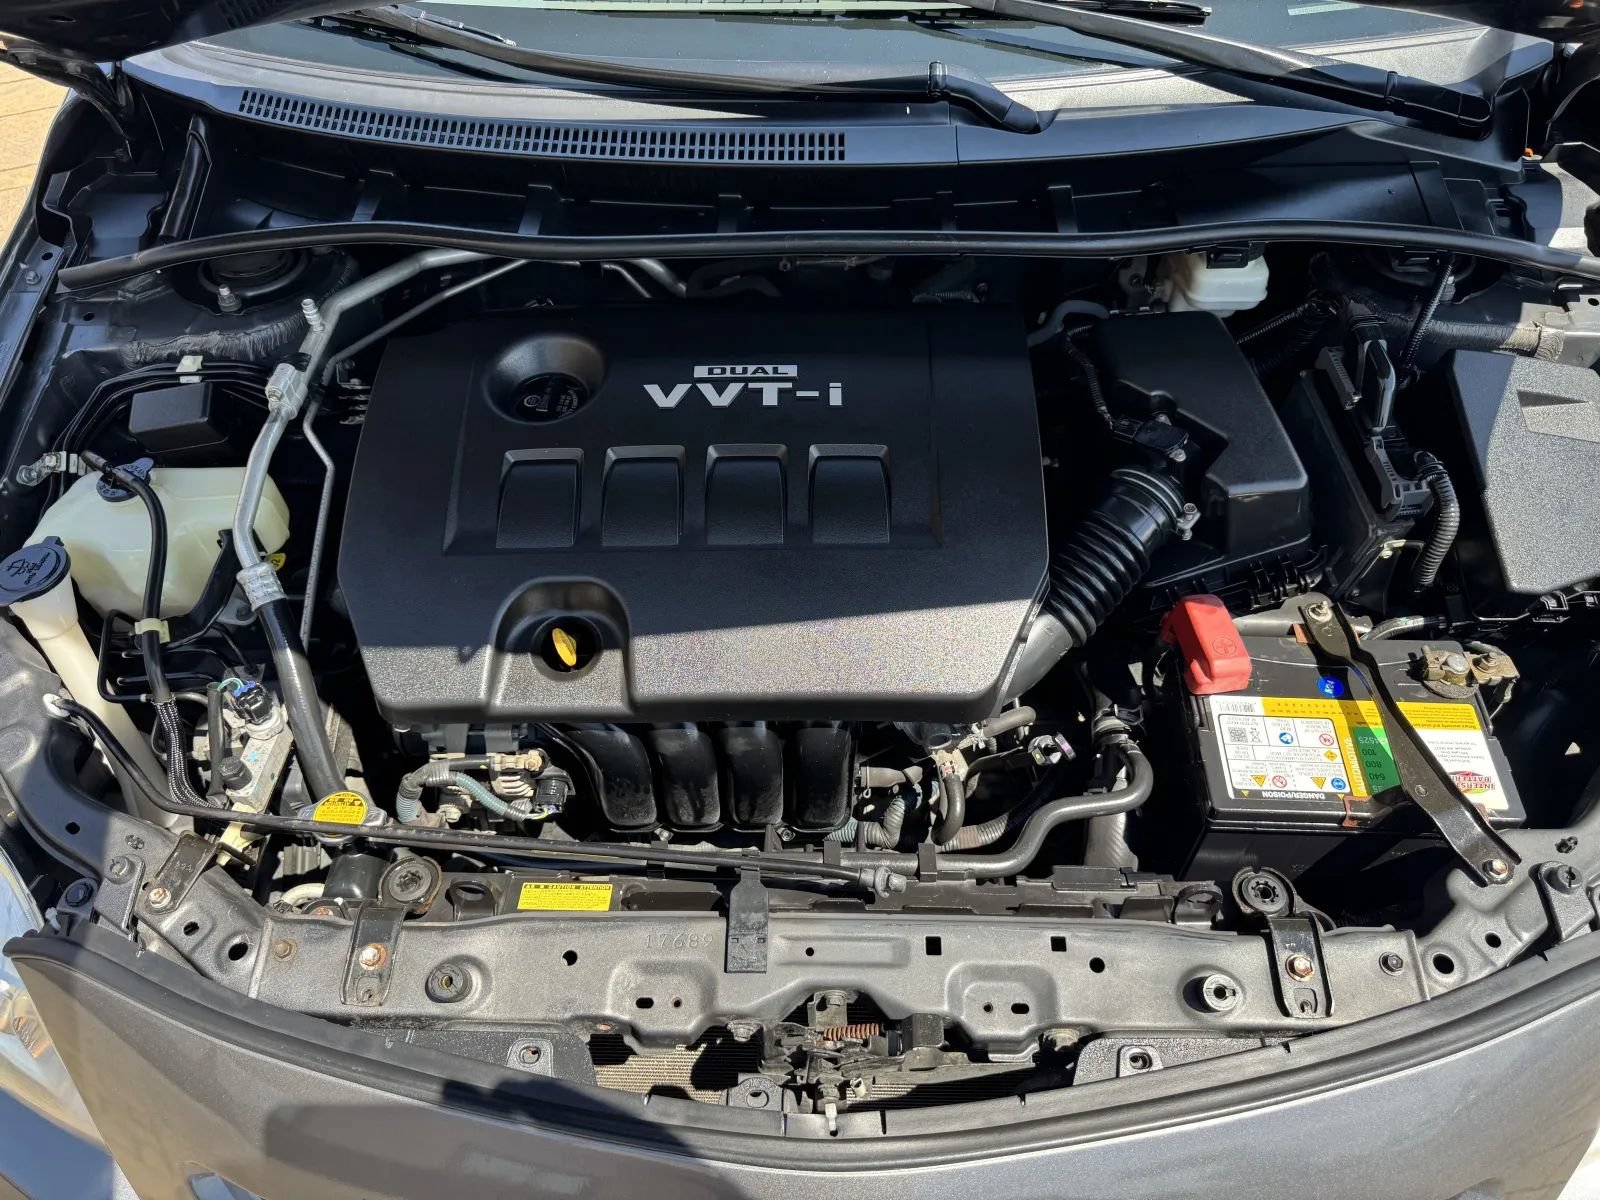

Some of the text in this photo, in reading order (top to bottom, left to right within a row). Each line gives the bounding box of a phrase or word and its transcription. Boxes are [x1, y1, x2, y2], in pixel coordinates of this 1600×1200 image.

[707, 366, 789, 376] DUAL
[643, 382, 842, 408] VVT-i
[1362, 748, 1377, 756] 100
[1344, 735, 1367, 793] AUTOMOTIVE
[1262, 790, 1326, 800] DANGER/POISON
[646, 932, 714, 950] 17689
